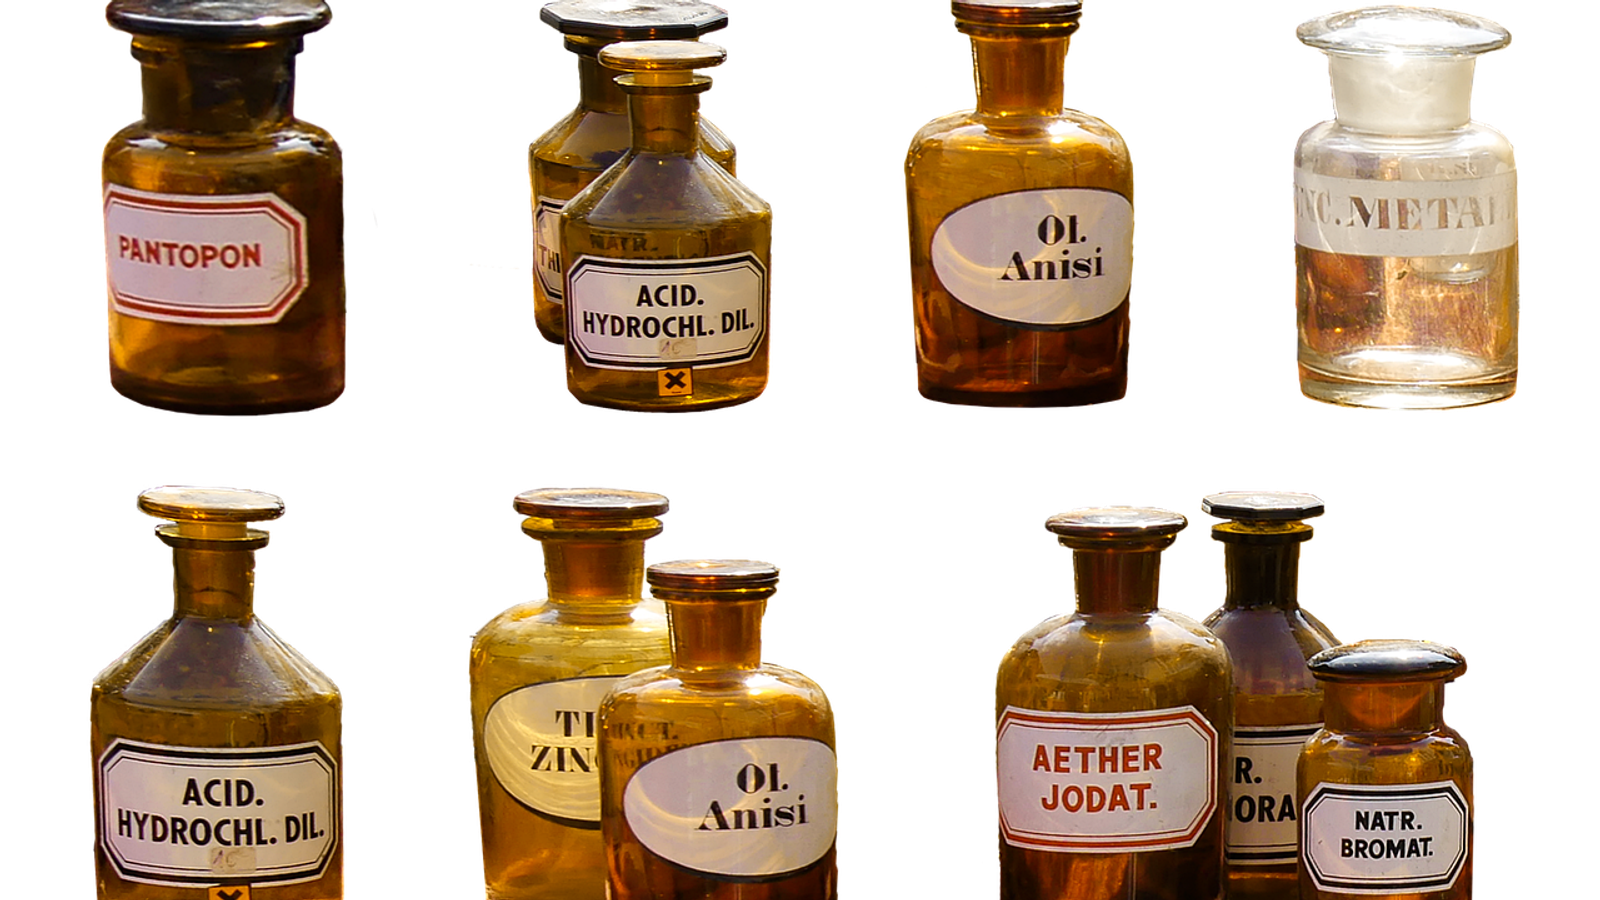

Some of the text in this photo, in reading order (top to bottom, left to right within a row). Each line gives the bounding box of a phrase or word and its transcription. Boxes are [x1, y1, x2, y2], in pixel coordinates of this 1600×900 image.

[1037, 214, 1087, 246] Ol.
[119, 235, 262, 269] PANTOPON
[997, 246, 1105, 281] Anisi
[636, 284, 705, 308] ACID.
[583, 308, 755, 339] HYDROCHL. DIL.
[531, 744, 599, 773] ZIN
[1033, 743, 1163, 773] AETHER
[182, 778, 264, 808] ACID.
[736, 762, 789, 794] Ol.
[694, 794, 809, 831] Anisi
[1041, 782, 1159, 813] JODAT.
[1230, 794, 1297, 823] ORA
[117, 808, 325, 847] HYDROCHL. DIL.
[1355, 810, 1423, 831] NATR.
[1341, 836, 1434, 860] BROMAT.
